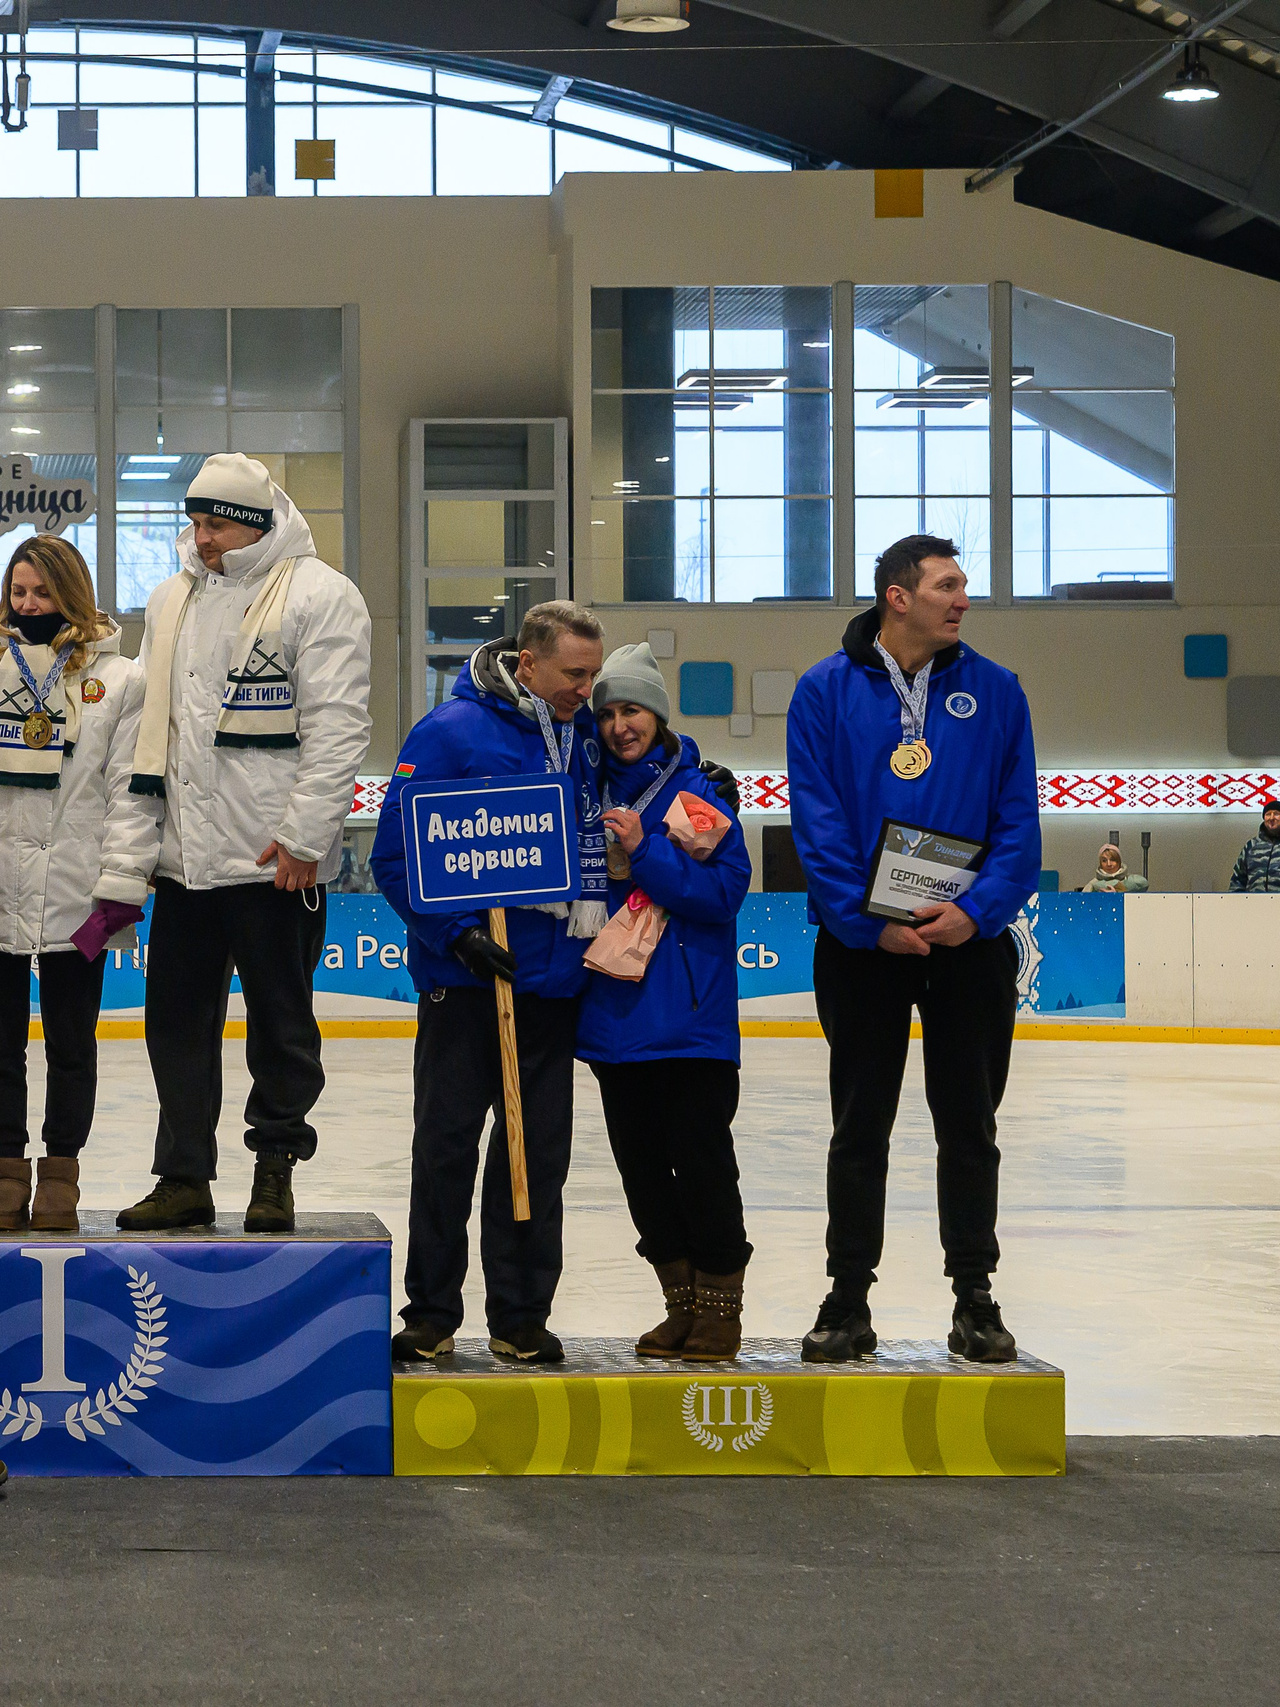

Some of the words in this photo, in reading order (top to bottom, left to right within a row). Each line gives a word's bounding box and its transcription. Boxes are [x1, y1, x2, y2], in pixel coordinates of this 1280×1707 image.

[213, 504, 265, 523] БЕЛАРУСЬ
[254, 686, 291, 701] ТИГРЫ
[427, 807, 554, 843] Академия
[444, 846, 542, 880] сервиса
[580, 858, 607, 868] ЕРВИ
[890, 868, 961, 895] СЕРТИФИКАТ
[21, 1248, 86, 1391] I
[697, 1386, 758, 1426] III
